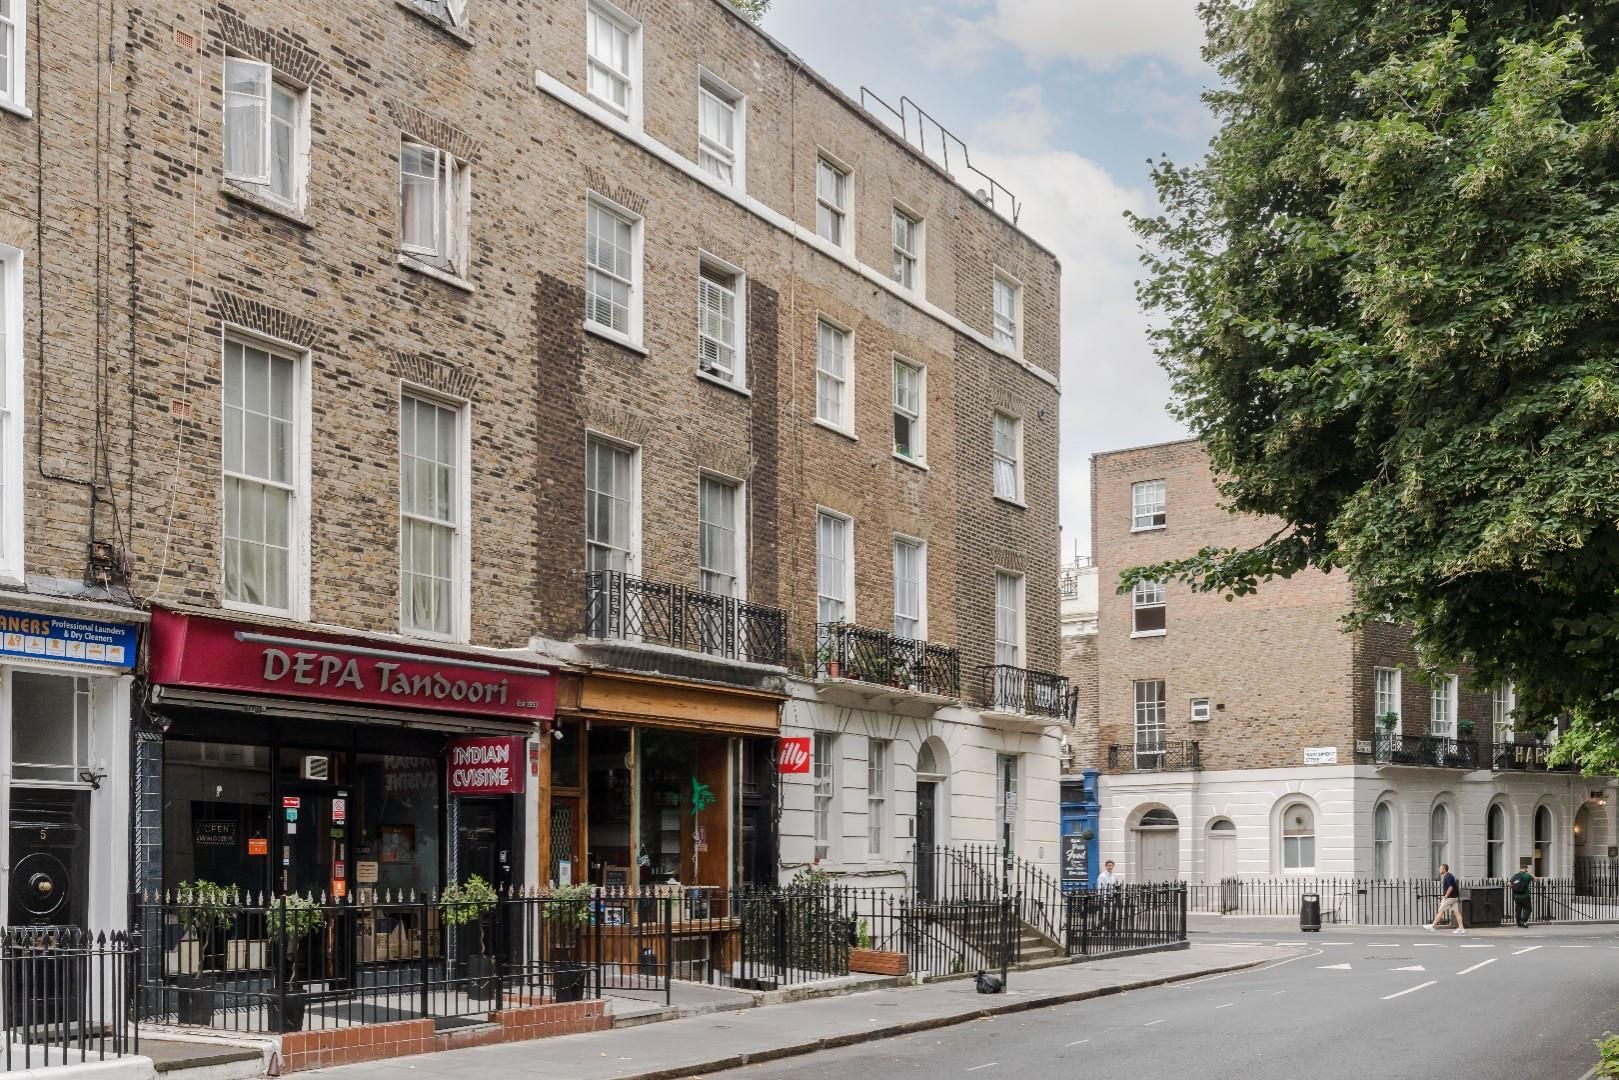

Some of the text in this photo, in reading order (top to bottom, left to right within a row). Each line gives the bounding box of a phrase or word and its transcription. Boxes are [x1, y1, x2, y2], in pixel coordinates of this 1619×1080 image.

[51, 619, 125, 636] Professional Launders
[70, 631, 83, 641] Dry
[84, 632, 113, 643] Cleaners
[261, 647, 510, 704] DEPA Tandoori
[452, 743, 510, 766] INDIAN
[779, 742, 809, 771] illy
[452, 766, 510, 788] CUISINE
[40, 829, 47, 840] 5
[1065, 849, 1087, 861] Food
